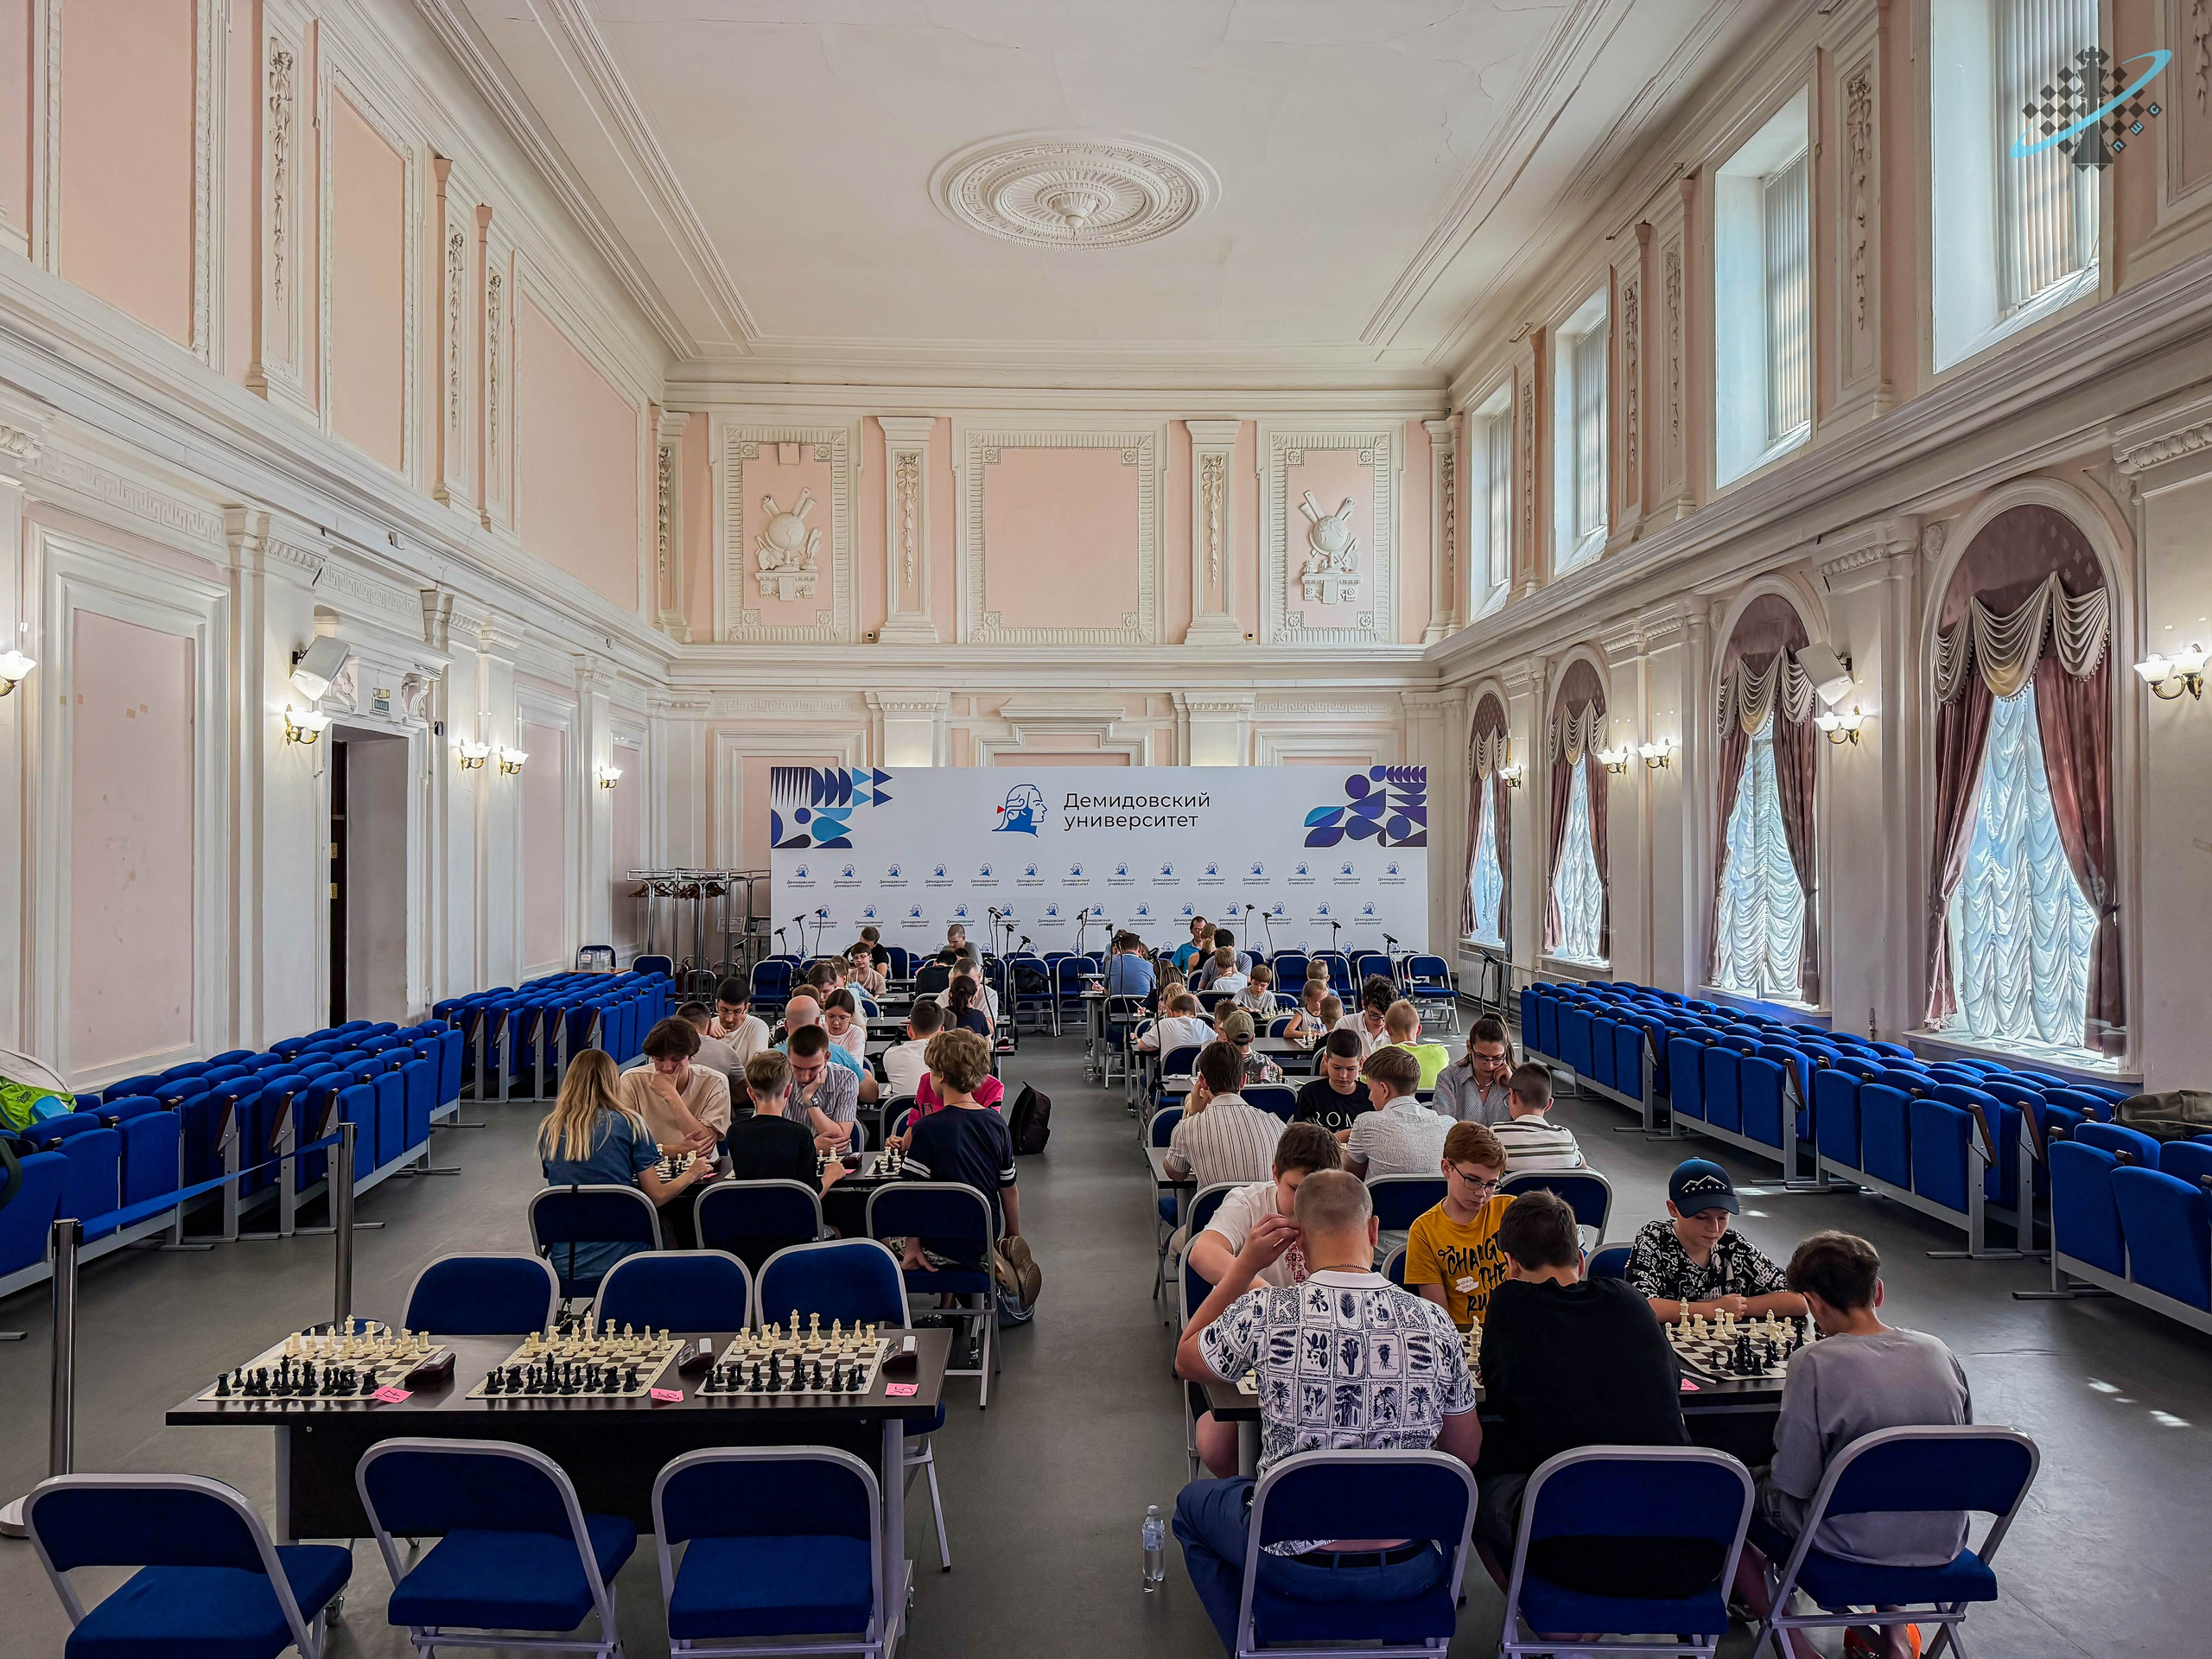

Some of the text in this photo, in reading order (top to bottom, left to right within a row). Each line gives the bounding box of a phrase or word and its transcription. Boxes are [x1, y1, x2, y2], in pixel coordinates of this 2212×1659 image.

[1063, 791, 1210, 810] Демидовский
[1064, 815, 1198, 832] университет
[1479, 1262, 1507, 1290] THE
[1275, 1300, 1293, 1319] K
